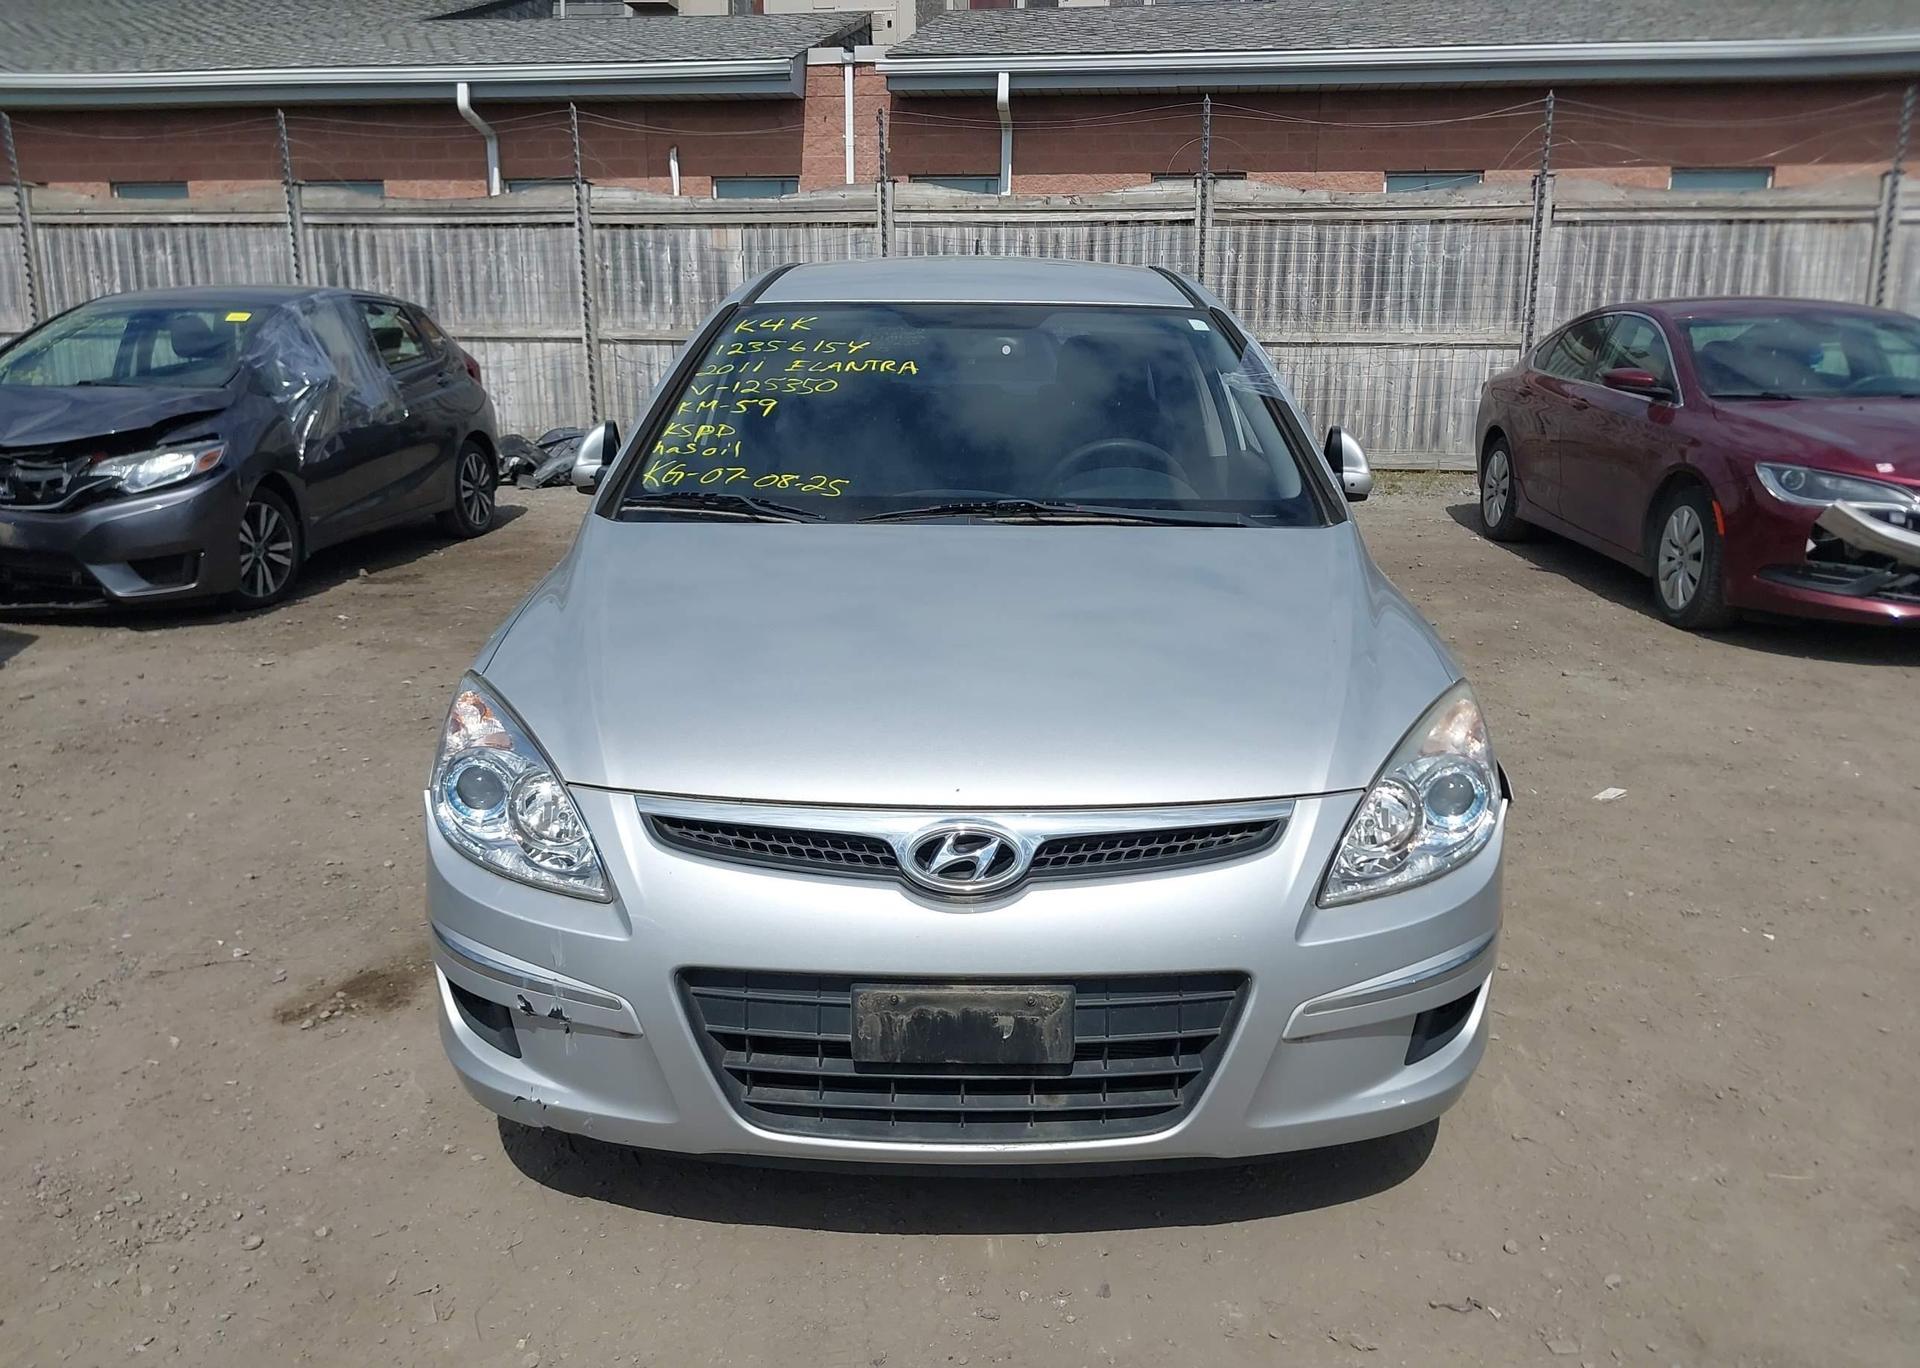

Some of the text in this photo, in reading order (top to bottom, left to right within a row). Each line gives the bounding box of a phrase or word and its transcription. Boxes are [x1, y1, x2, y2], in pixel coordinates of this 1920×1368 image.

[734, 316, 818, 333] K4K
[695, 360, 764, 377] 2011
[691, 377, 839, 396] V-125350
[677, 398, 778, 417] KM-59
